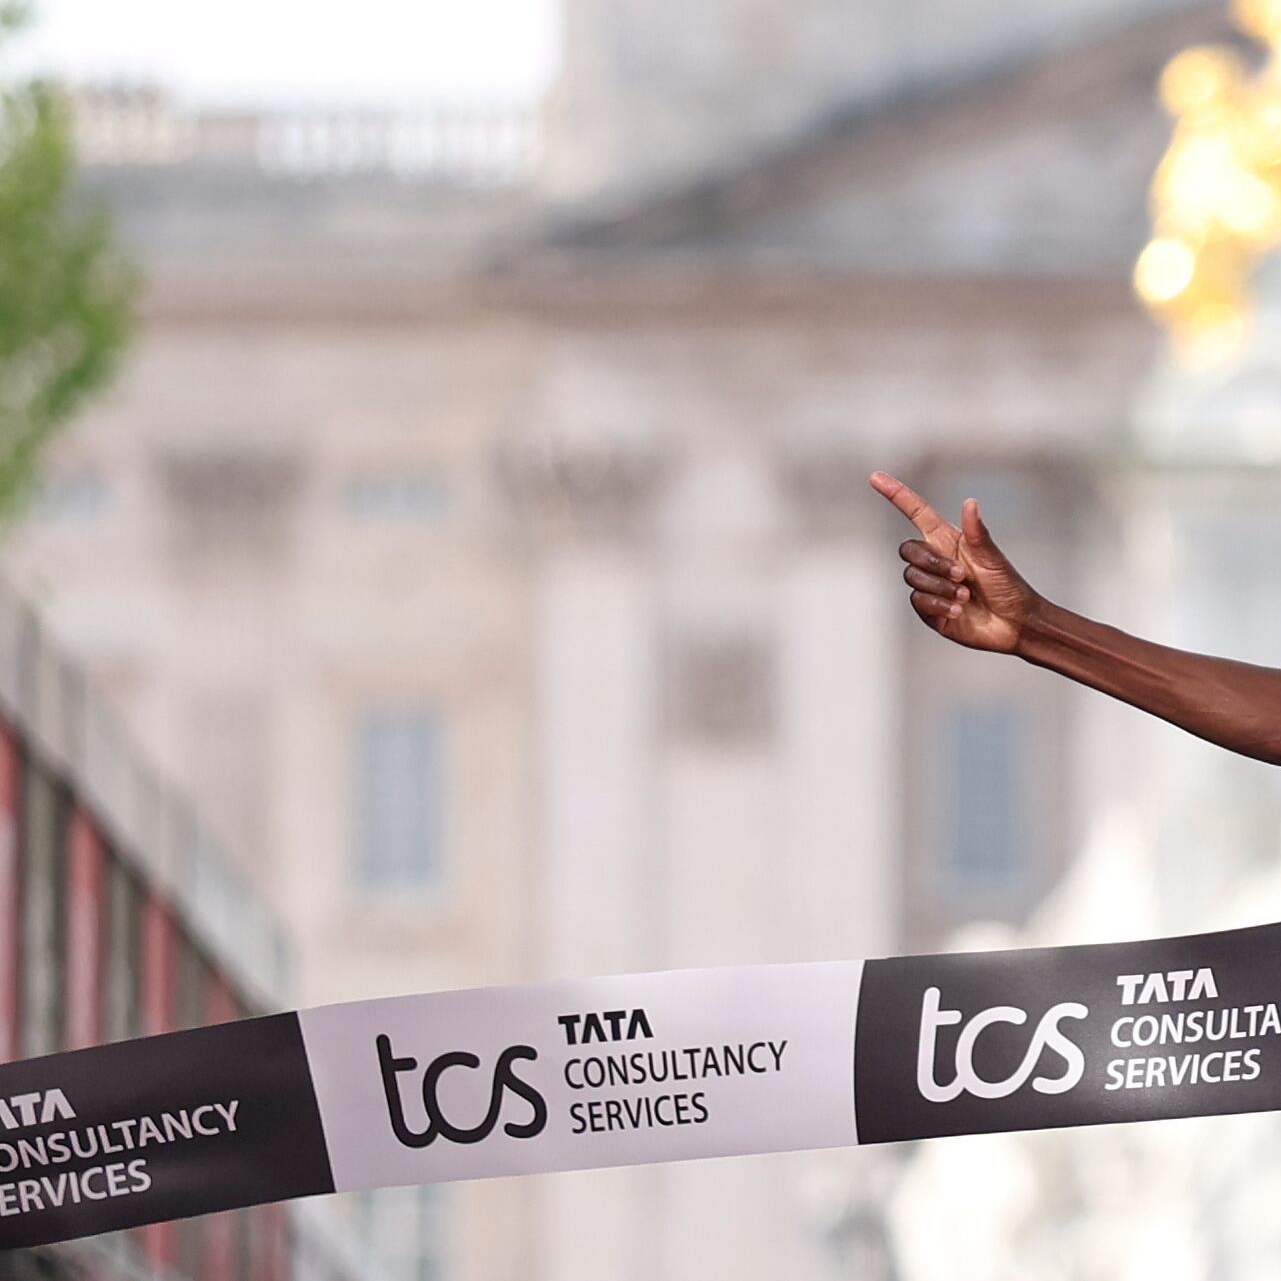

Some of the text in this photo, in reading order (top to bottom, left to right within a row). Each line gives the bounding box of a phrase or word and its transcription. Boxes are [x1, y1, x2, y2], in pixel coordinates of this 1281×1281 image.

[1117, 968, 1219, 1006] TATA
[558, 1009, 654, 1047] TATA
[918, 986, 1089, 1103] tcs
[565, 1041, 787, 1090] CONSULTANCY
[1104, 1049, 1261, 1091] SERVICES
[0, 1088, 77, 1130] ATA
[376, 1034, 548, 1149] tcs
[570, 1093, 709, 1134] SERVICES
[0, 1101, 239, 1173] ONSULTANCY
[0, 1159, 152, 1217] ERVICES
